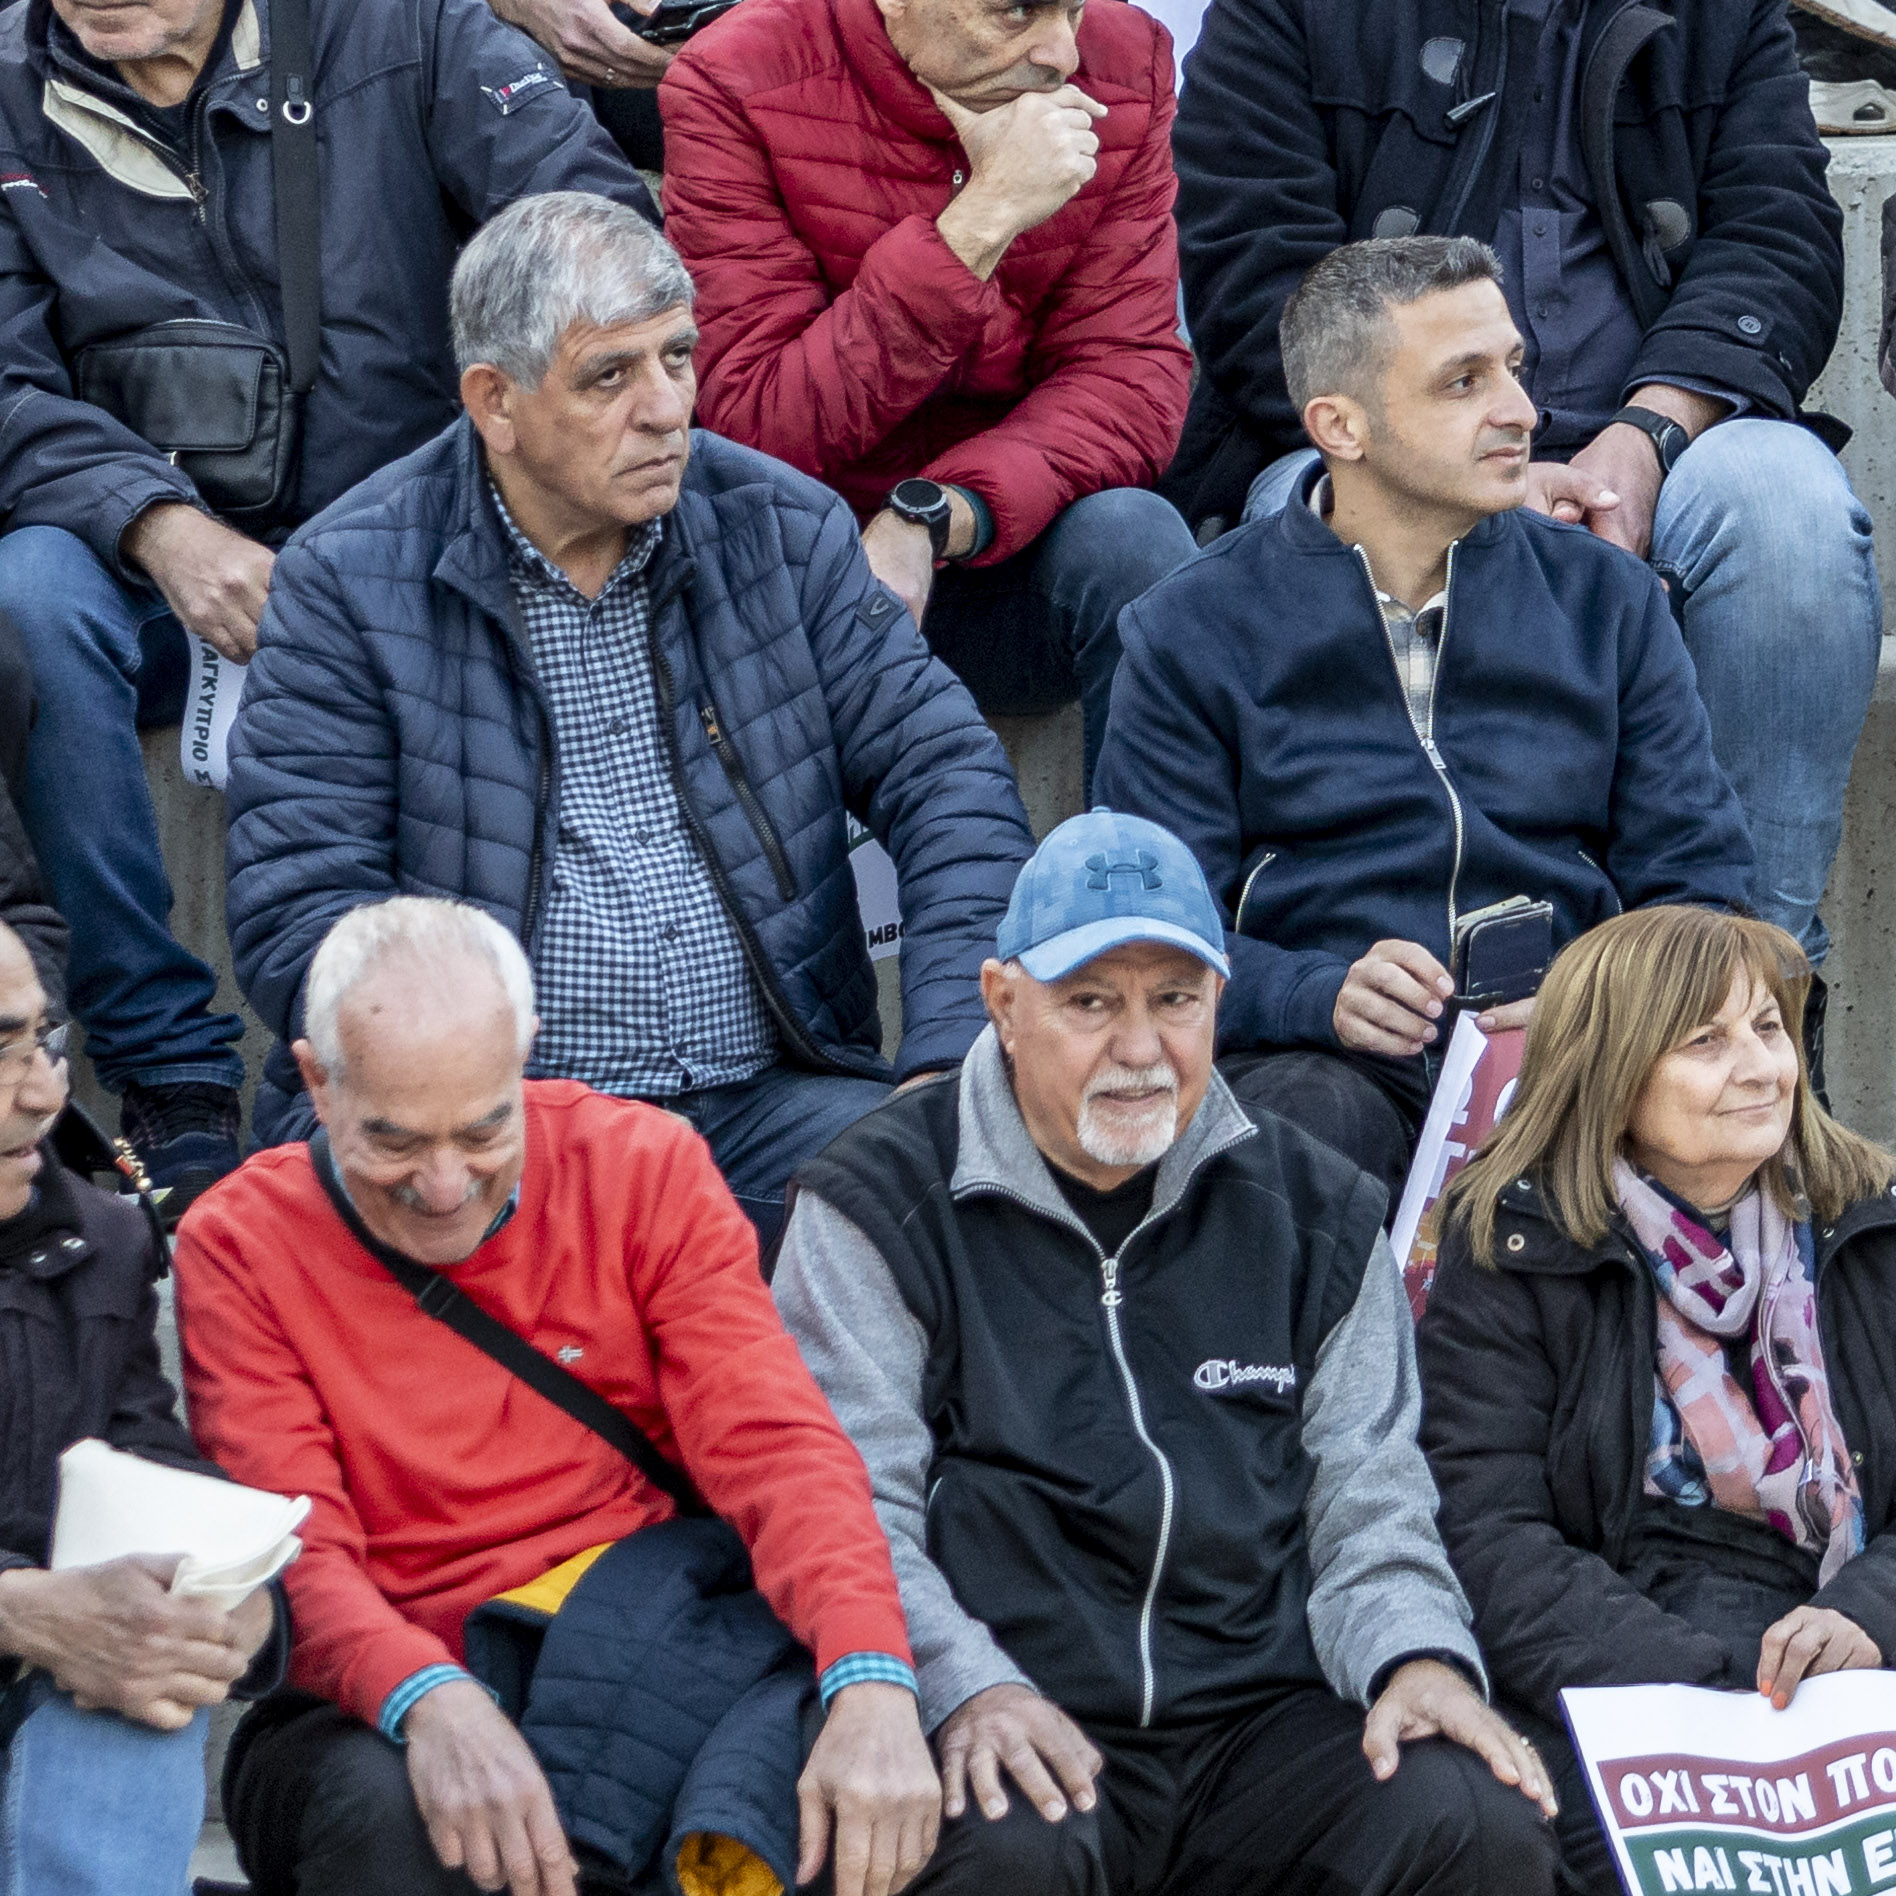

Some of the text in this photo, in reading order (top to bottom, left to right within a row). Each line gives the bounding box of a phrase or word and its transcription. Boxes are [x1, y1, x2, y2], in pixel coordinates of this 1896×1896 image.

[191, 638, 220, 762] ΑΓΚΥΠΡΙΟ
[1620, 1768, 1700, 1818] ΟΧΙ
[1701, 1770, 1817, 1824] ΣΤΟΝ
[1653, 1846, 1737, 1894] ΝΑΙ
[1739, 1847, 1853, 1896] ΣΤΗΝ
